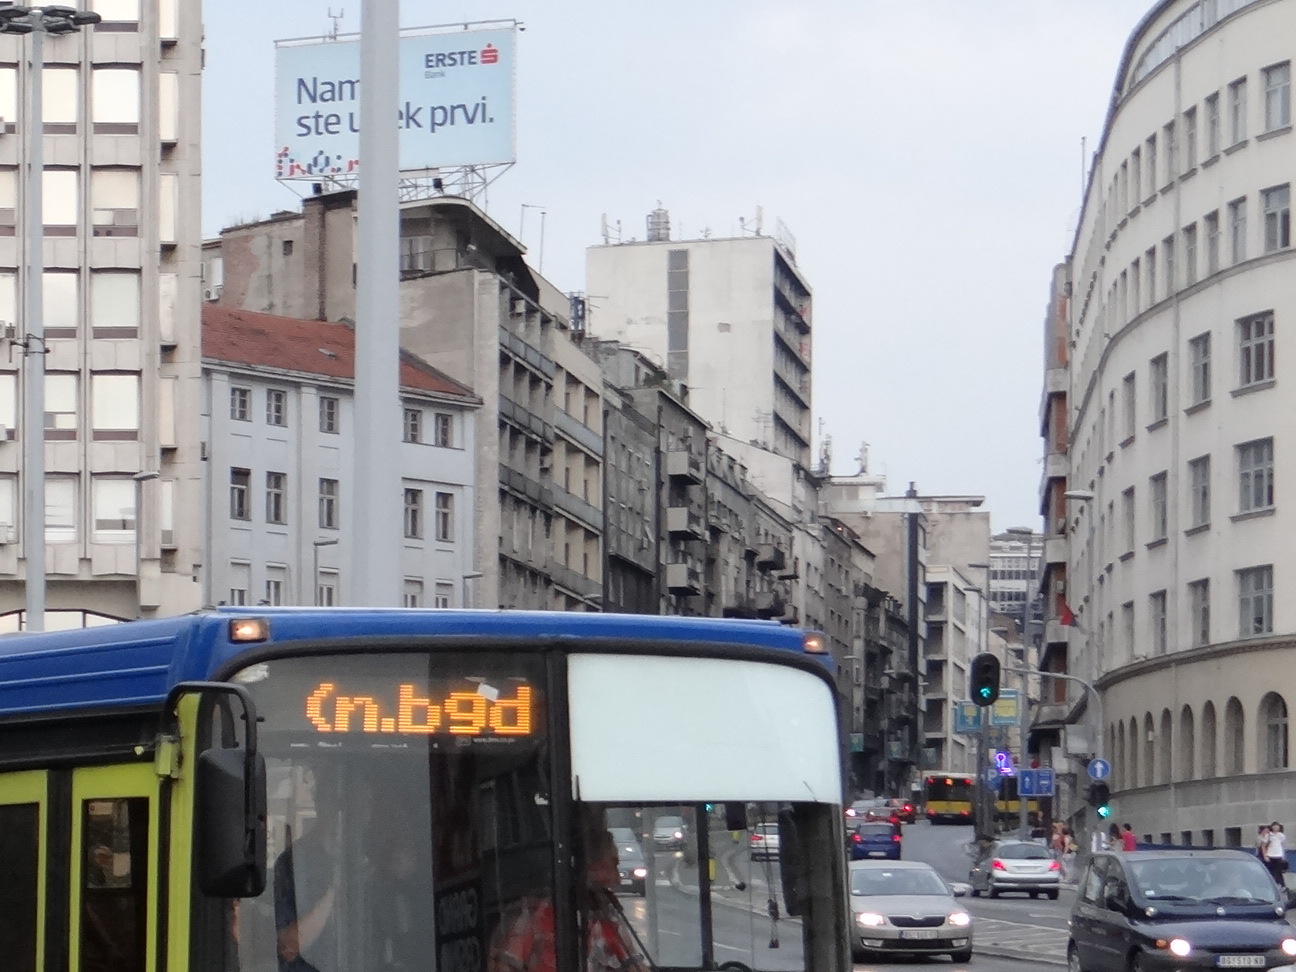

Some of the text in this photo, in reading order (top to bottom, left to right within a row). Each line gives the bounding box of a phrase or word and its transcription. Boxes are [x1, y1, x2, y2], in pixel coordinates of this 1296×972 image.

[424, 50, 478, 69] ERSTE
[296, 76, 361, 105] Nam
[296, 110, 341, 138] ste
[429, 96, 495, 134] prvi.
